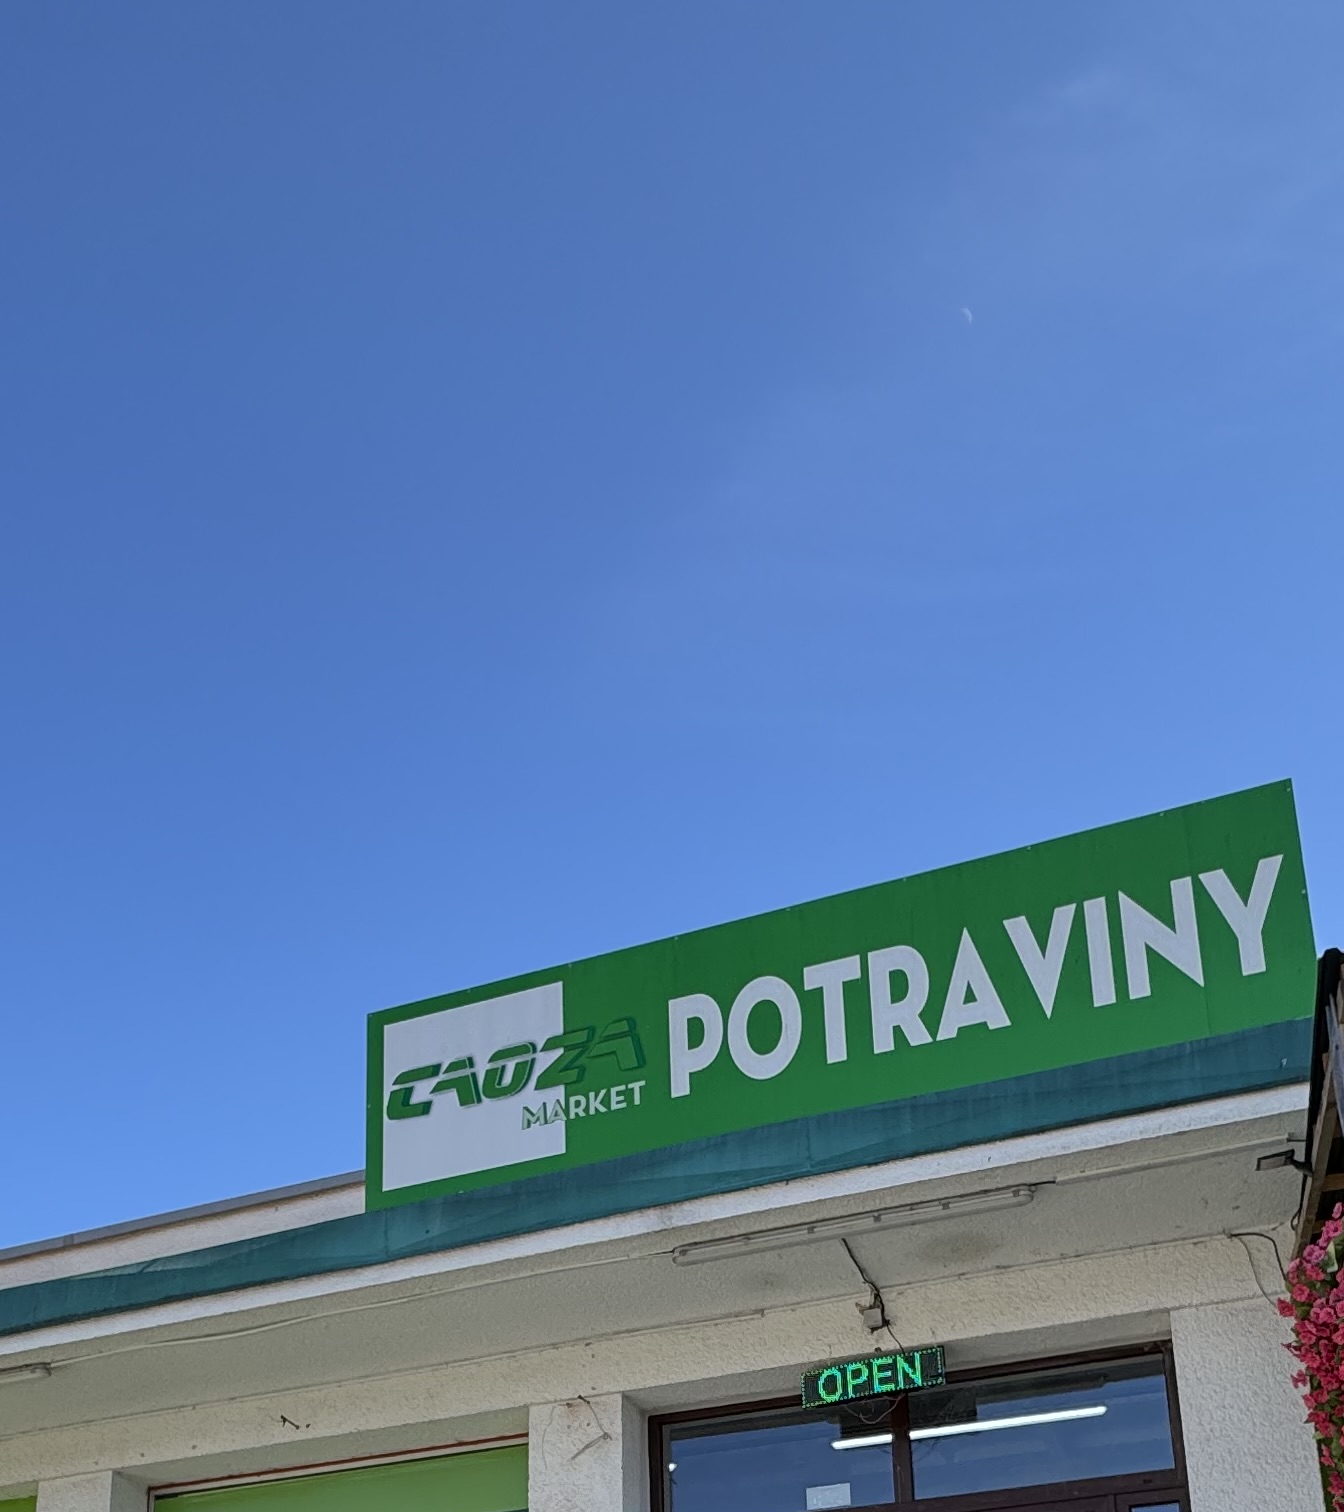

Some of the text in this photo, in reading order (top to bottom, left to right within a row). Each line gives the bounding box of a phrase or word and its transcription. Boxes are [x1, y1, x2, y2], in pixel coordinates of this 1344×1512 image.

[668, 854, 1284, 1099] POTRAVINY
[521, 1079, 647, 1131] MARKET
[818, 1352, 922, 1402] OPEN
